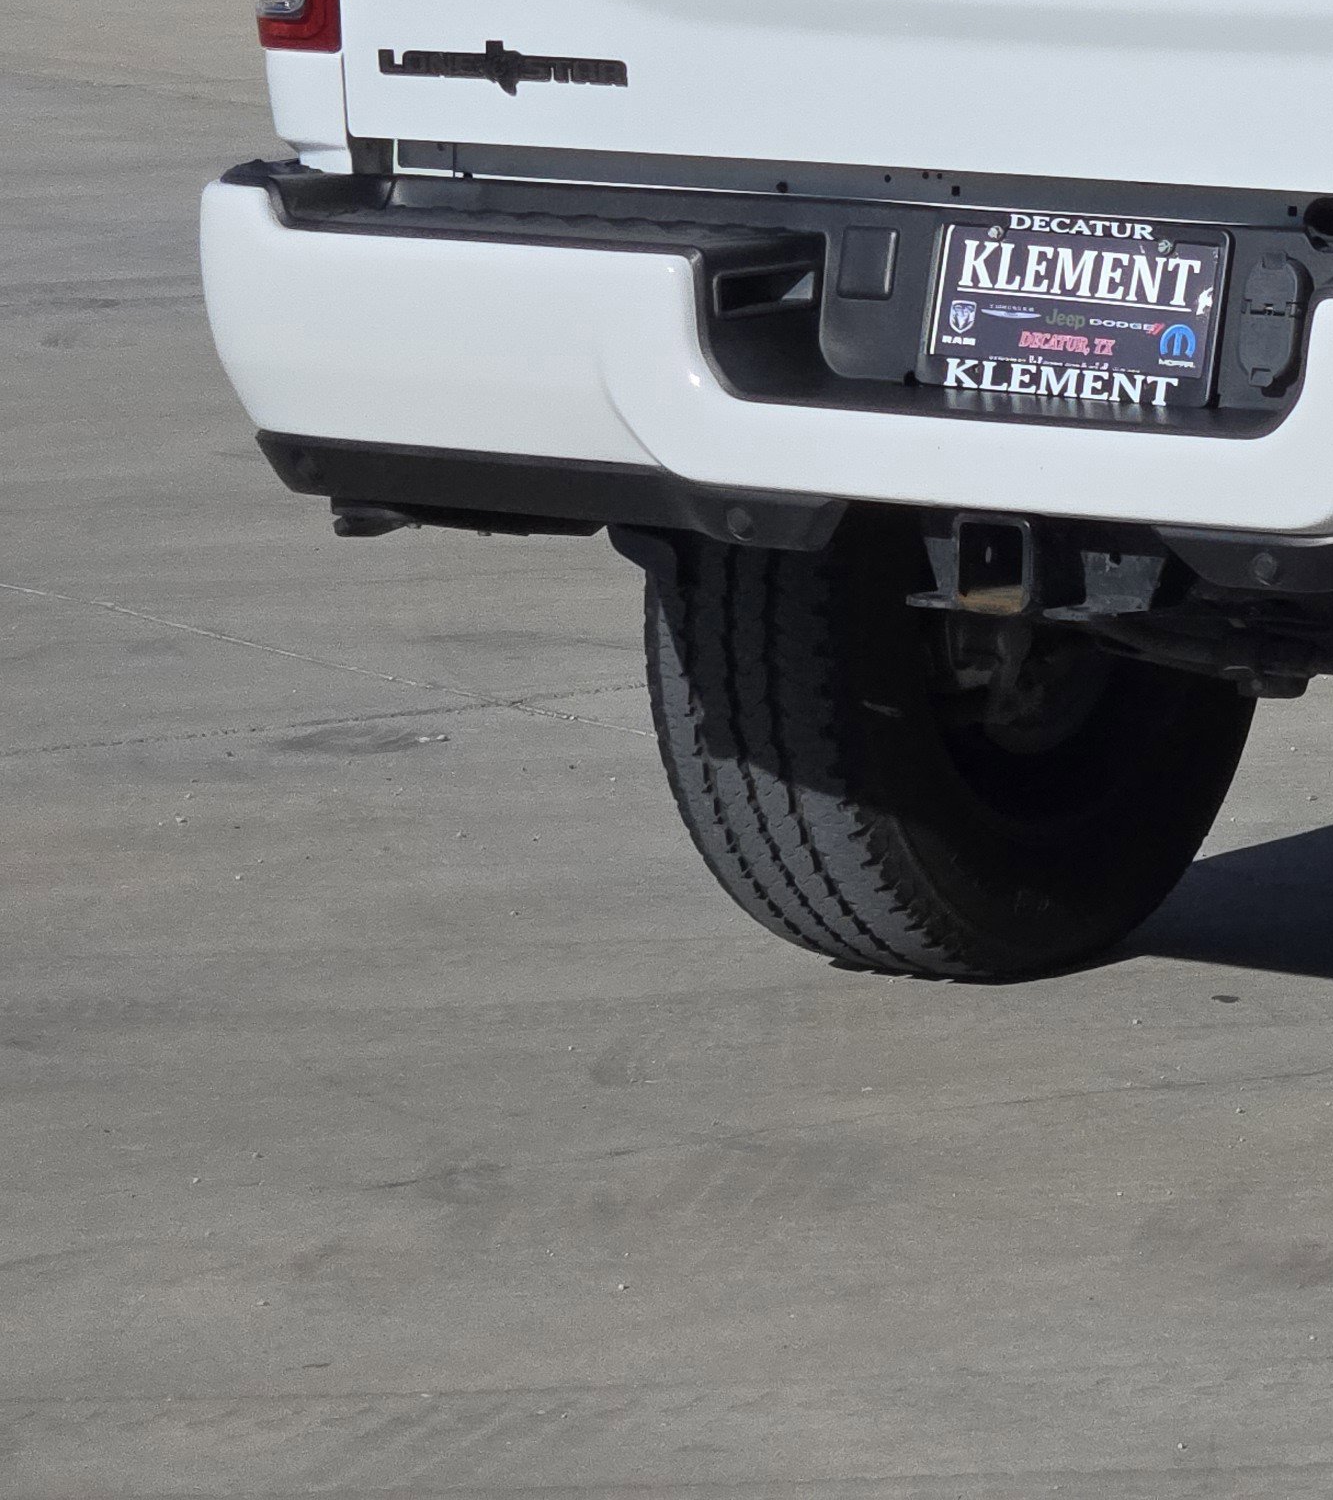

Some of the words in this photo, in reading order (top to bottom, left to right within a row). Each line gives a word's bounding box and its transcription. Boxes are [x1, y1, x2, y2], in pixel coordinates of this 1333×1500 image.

[1009, 213, 1155, 241] DECATUR
[958, 239, 1201, 306] KLEMENT
[1045, 308, 1086, 330] Jeep
[1089, 318, 1156, 332] DODGE
[942, 335, 976, 346] RAM
[1093, 338, 1116, 355] TX
[943, 357, 1179, 407] KLEMENT
